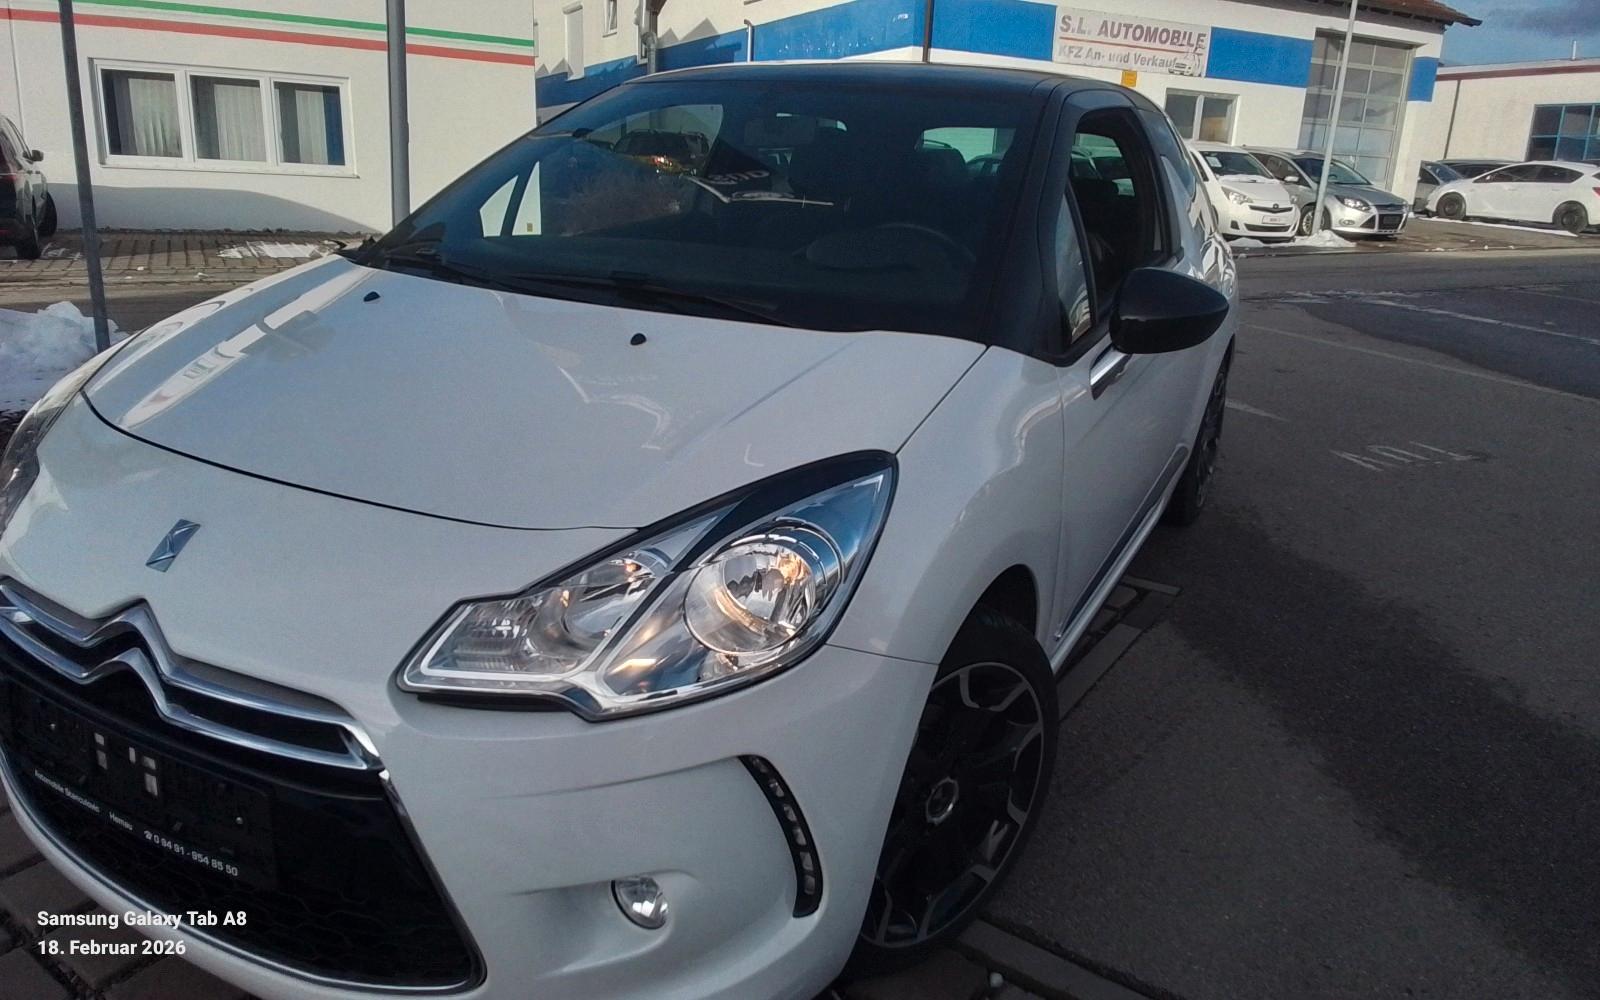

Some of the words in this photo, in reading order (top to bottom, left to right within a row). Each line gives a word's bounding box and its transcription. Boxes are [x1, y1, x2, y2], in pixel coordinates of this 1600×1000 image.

[1060, 14, 1090, 36] S.L.
[1097, 19, 1207, 50] AUTOMOBILE
[1058, 44, 1084, 59] KFZ
[1109, 52, 1131, 64] und
[225, 864, 238, 877] 50
